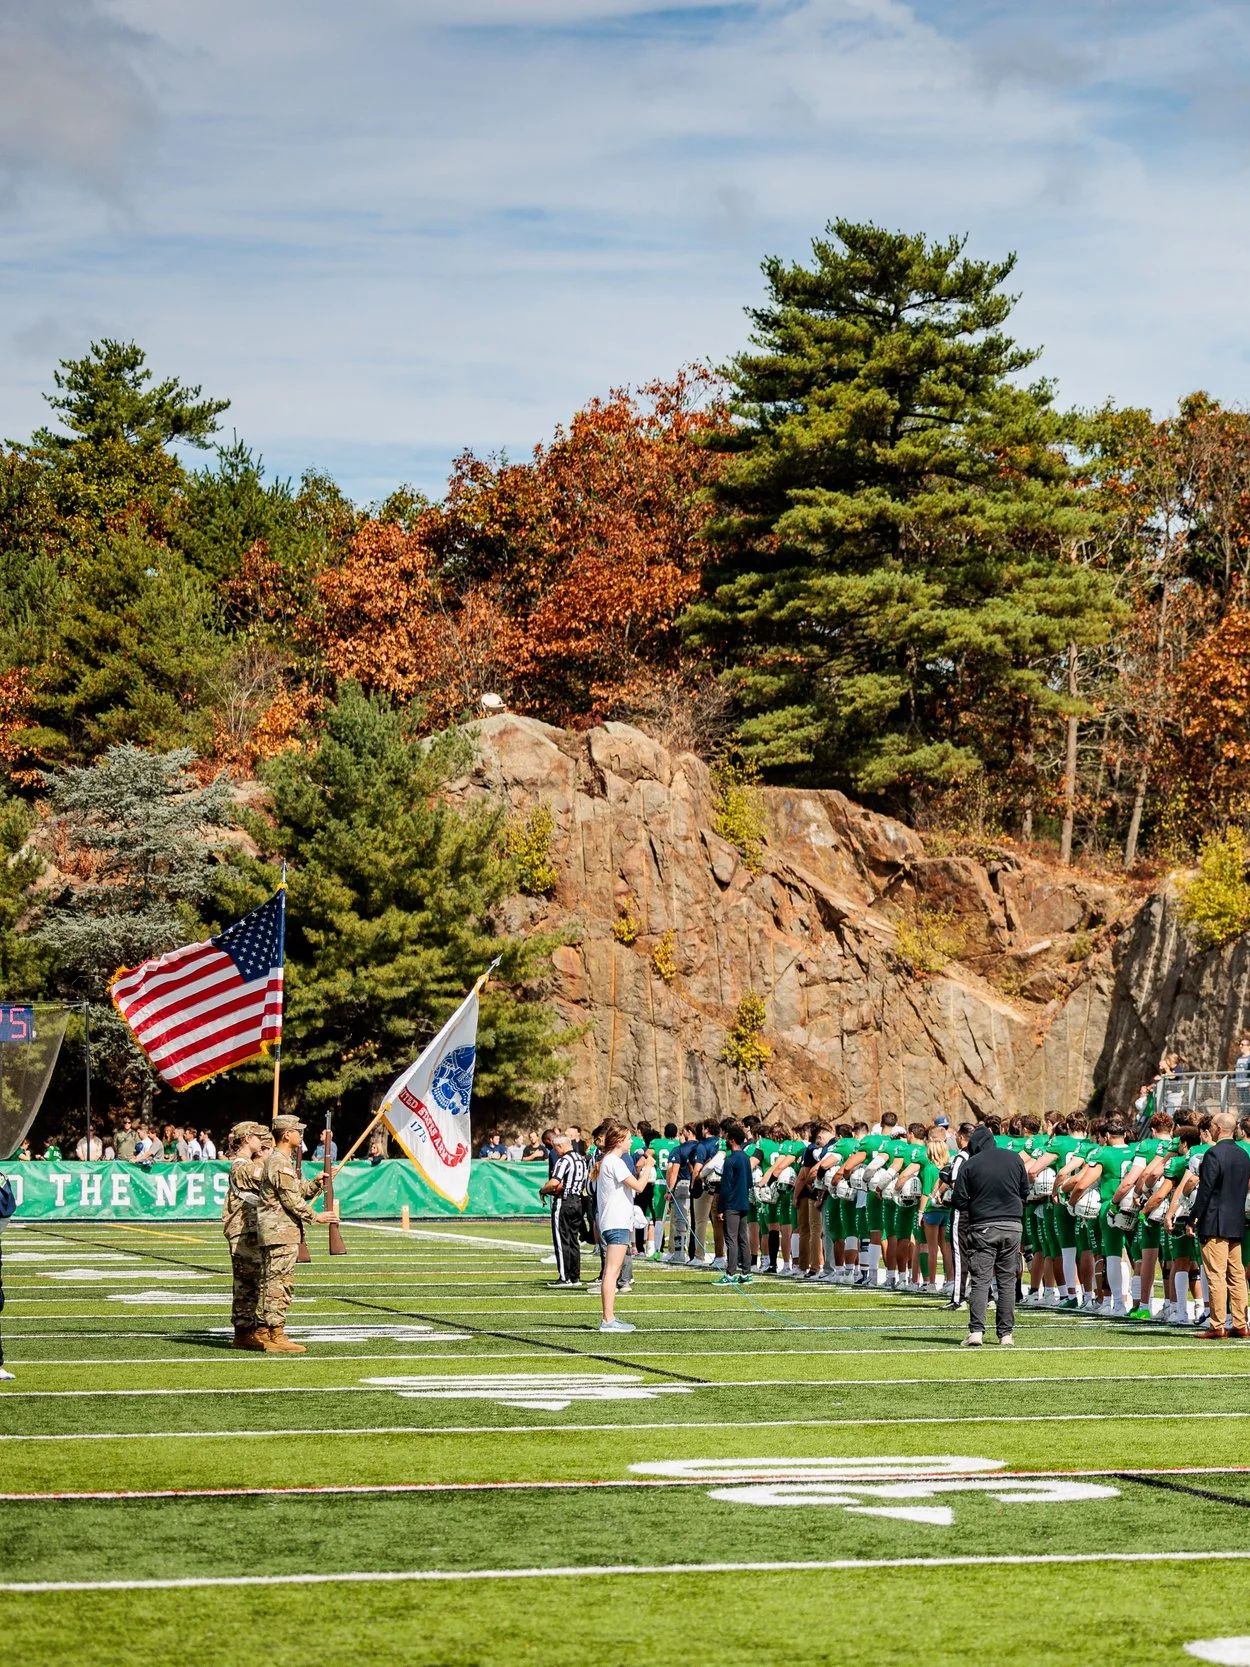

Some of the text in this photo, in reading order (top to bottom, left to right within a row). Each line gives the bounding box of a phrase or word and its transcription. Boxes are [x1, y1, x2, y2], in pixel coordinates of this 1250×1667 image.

[0, 1008, 27, 1038] 5
[401, 1087, 418, 1109] ITED
[433, 1136, 454, 1165] ARMY
[50, 1173, 131, 1207] THE
[155, 1172, 230, 1206] NES
[628, 1455, 1123, 1506] 30
